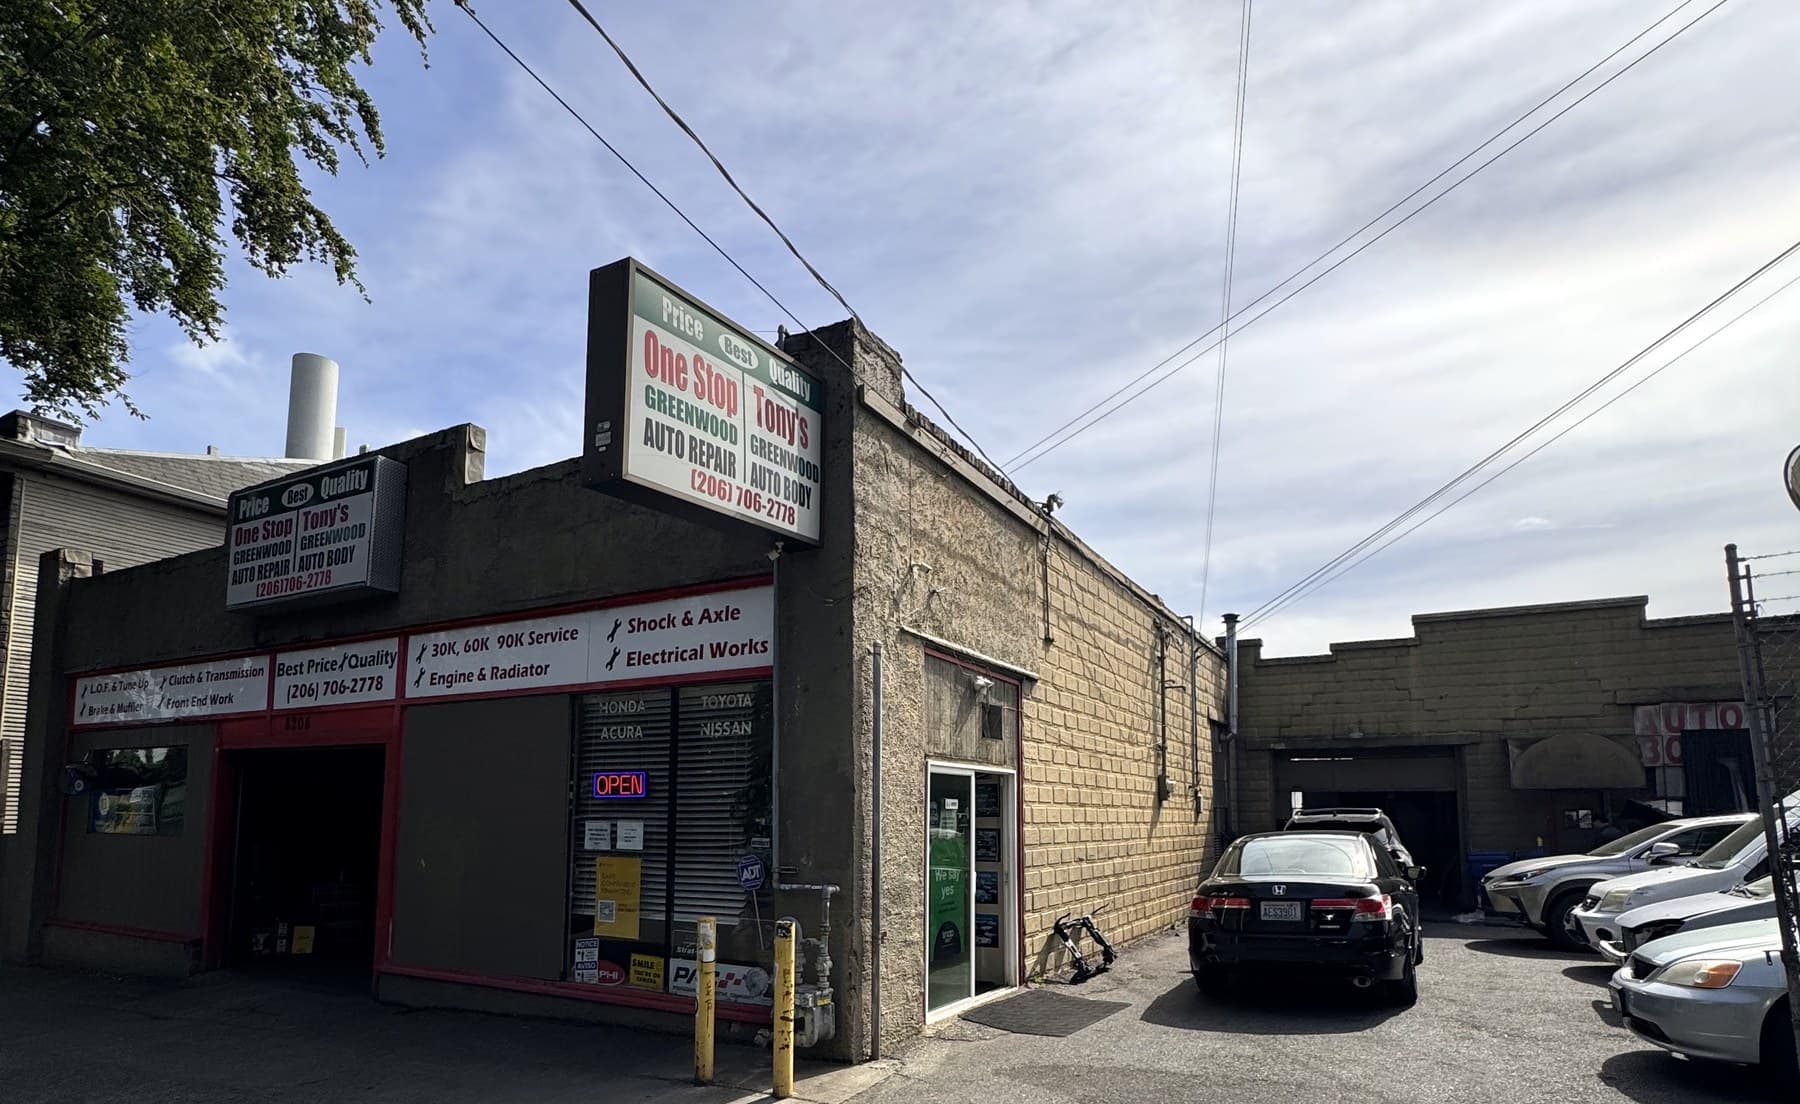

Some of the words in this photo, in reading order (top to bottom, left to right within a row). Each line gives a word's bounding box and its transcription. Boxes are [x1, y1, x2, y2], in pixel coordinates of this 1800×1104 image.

[662, 295, 704, 341] Price
[724, 336, 754, 367] Best
[644, 329, 688, 392] One
[693, 353, 738, 417] Stop
[769, 358, 810, 402] Quality
[645, 384, 738, 446] GREENWOOD
[753, 384, 808, 450] Tony's
[643, 417, 685, 459] AUTO
[688, 438, 737, 479] REPAIR
[750, 434, 820, 484] GREENWOOD
[287, 487, 308, 505] Best
[321, 469, 368, 499] Quality
[691, 468, 733, 505] (206)
[736, 485, 795, 525] 706-2778
[751, 461, 781, 497] AUTO
[783, 475, 812, 510] BODY
[239, 496, 270, 519] Price
[303, 503, 349, 532] Tony's
[235, 527, 259, 547] One
[263, 518, 293, 540] Stop
[300, 523, 366, 551] GREENWOOD
[233, 540, 292, 566] GREENWOOD
[299, 551, 324, 573] AUTO
[327, 545, 355, 568] BODY
[231, 567, 255, 586] AUTO
[257, 559, 290, 581] REPAIR
[627, 613, 676, 634] Shock
[681, 610, 694, 627] &
[698, 605, 741, 625] Axle
[431, 641, 460, 657] 30K,
[497, 632, 525, 650] 90K
[528, 627, 579, 646] Service
[626, 644, 704, 667] Electrical
[709, 638, 769, 659] Works
[168, 672, 195, 687] Clutch
[197, 672, 203, 683] &
[206, 666, 264, 682] Transmission
[277, 662, 304, 677] Best
[307, 657, 338, 674] Price
[347, 650, 398, 669] Quality
[429, 670, 474, 689] Engine
[477, 667, 487, 681] &
[490, 663, 550, 681] Radiator
[111, 681, 117, 692] &
[119, 679, 137, 691] Tune
[138, 678, 149, 692] Up
[287, 682, 319, 704] (206)
[323, 675, 384, 696] 706-2778
[88, 703, 109, 716] Brake
[110, 703, 116, 714] &
[117, 702, 143, 713] Muffler
[166, 697, 189, 709] Front
[191, 695, 207, 707] End
[210, 693, 234, 706] Work
[600, 699, 645, 714] HONDA
[702, 693, 753, 709] TOYOTA
[601, 725, 643, 740] ACURA
[701, 721, 752, 737] NISSAN
[596, 774, 643, 795] OPEN
[742, 865, 761, 881] ADT
[935, 869, 947, 881] We
[948, 870, 960, 882] say
[941, 885, 954, 900] yes
[576, 940, 598, 949] NOTICE
[632, 958, 655, 969] SMILE
